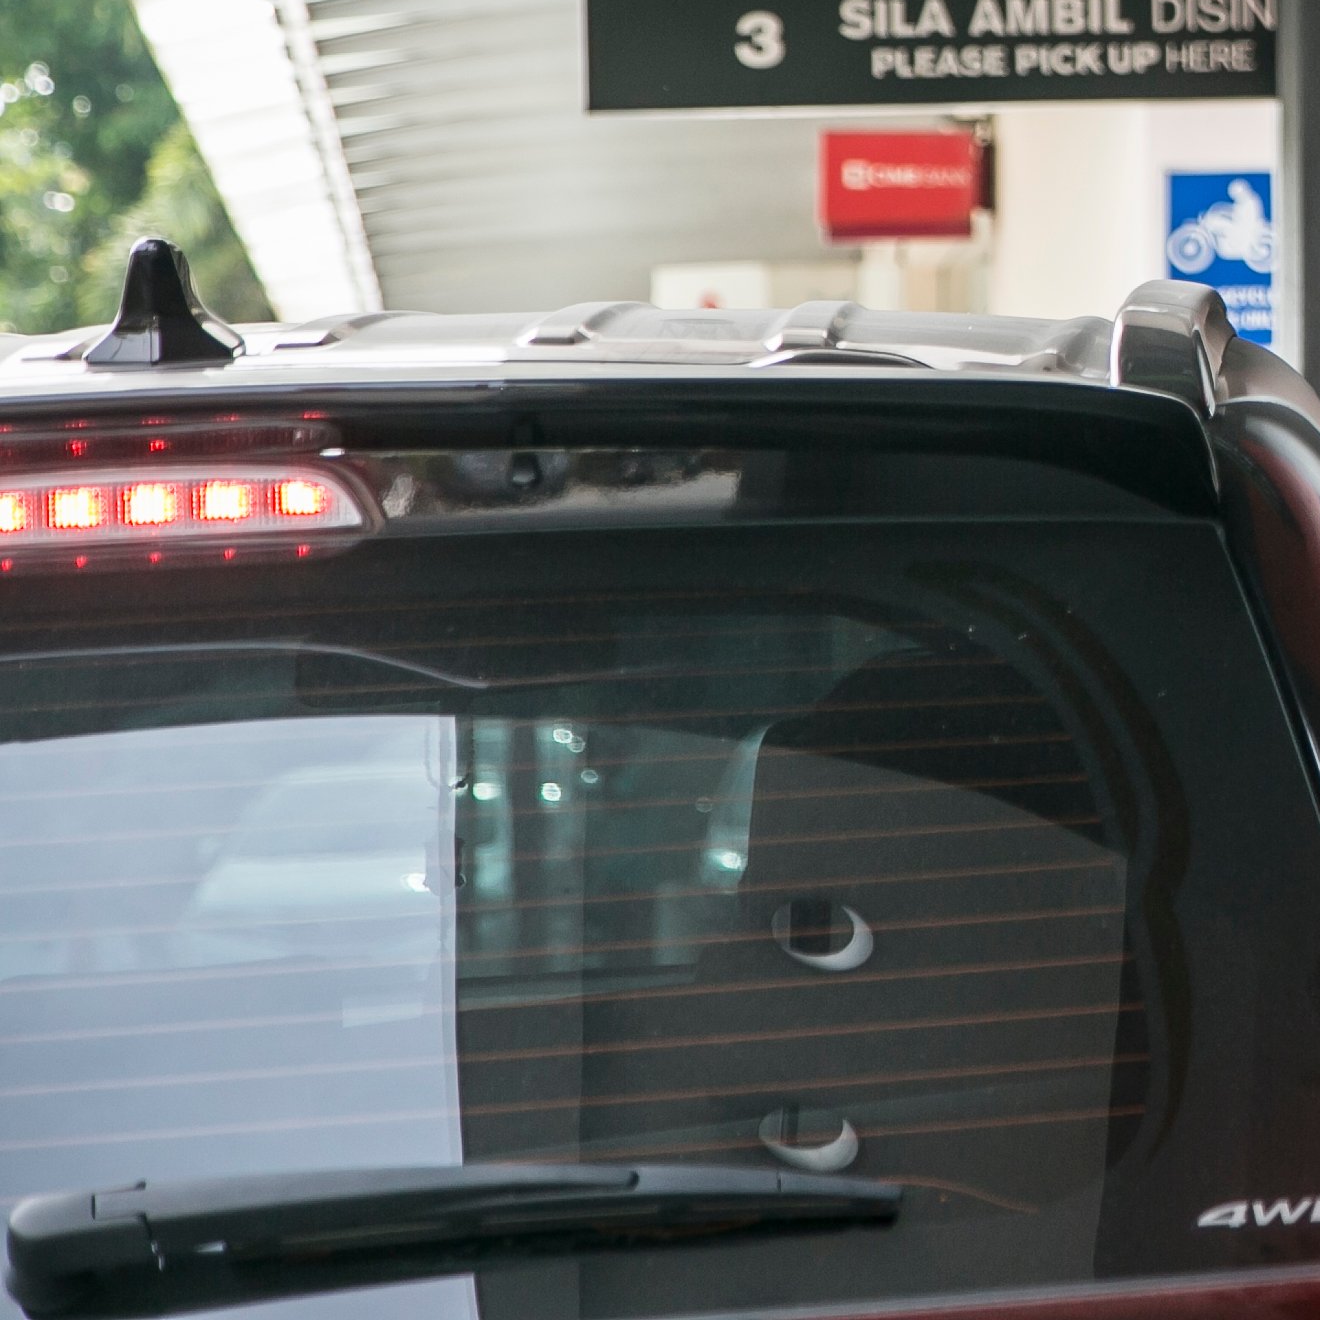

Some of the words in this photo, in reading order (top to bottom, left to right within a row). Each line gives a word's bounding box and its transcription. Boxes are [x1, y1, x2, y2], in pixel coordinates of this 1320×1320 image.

[734, 10, 786, 69] 3
[870, 44, 1008, 79] PLEASE
[1014, 42, 1105, 76] PICK
[1107, 41, 1161, 75] UP
[1165, 40, 1253, 73] HERE
